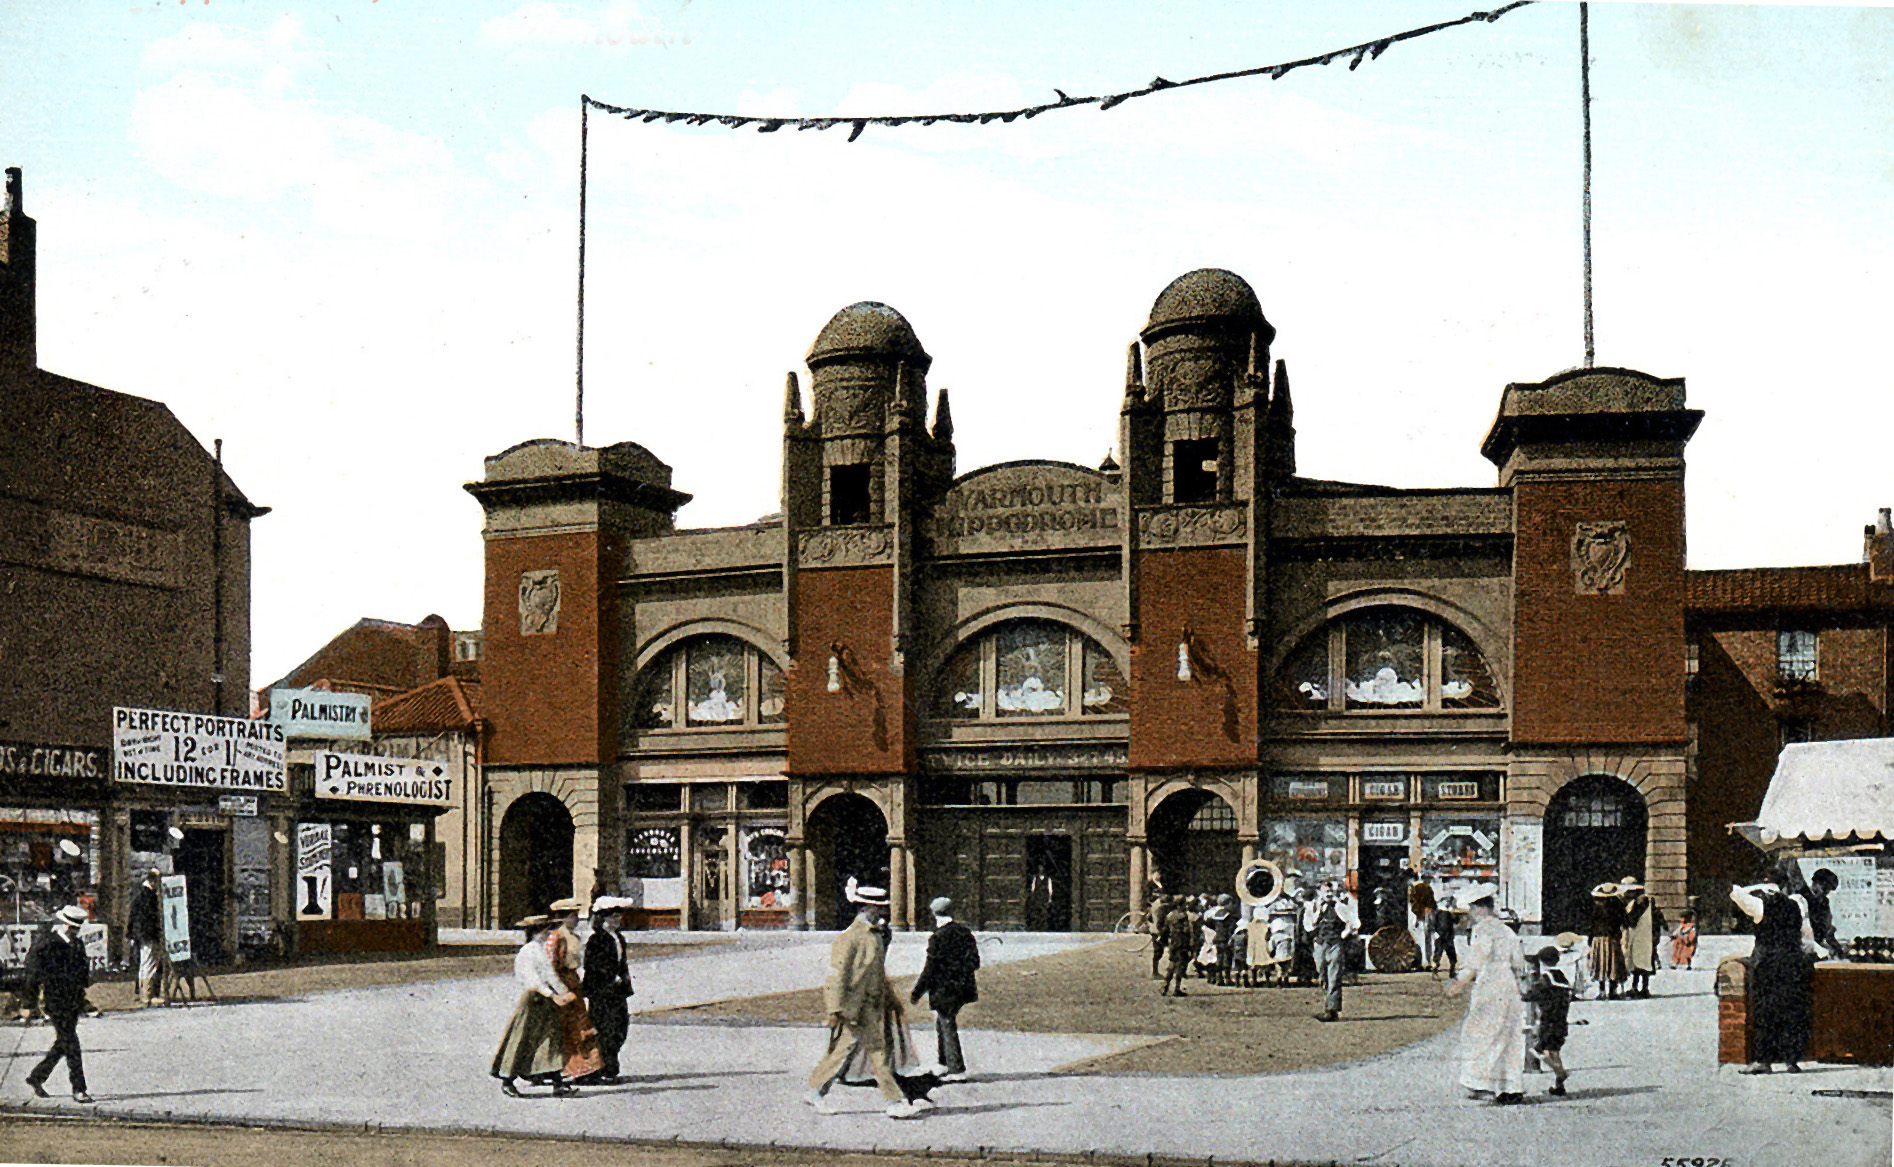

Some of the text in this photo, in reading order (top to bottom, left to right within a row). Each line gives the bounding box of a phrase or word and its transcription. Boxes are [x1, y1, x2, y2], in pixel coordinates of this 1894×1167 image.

[291, 698, 357, 723] PALMISTRY
[117, 709, 284, 743] PERFECT PORTRAITS
[174, 735, 198, 763] 12
[117, 761, 284, 790] INCLUDING FRAMES
[323, 754, 426, 782] PALMIST &
[346, 780, 453, 801] PHRENOLOGIST
[1368, 825, 1399, 837] CIGAR
